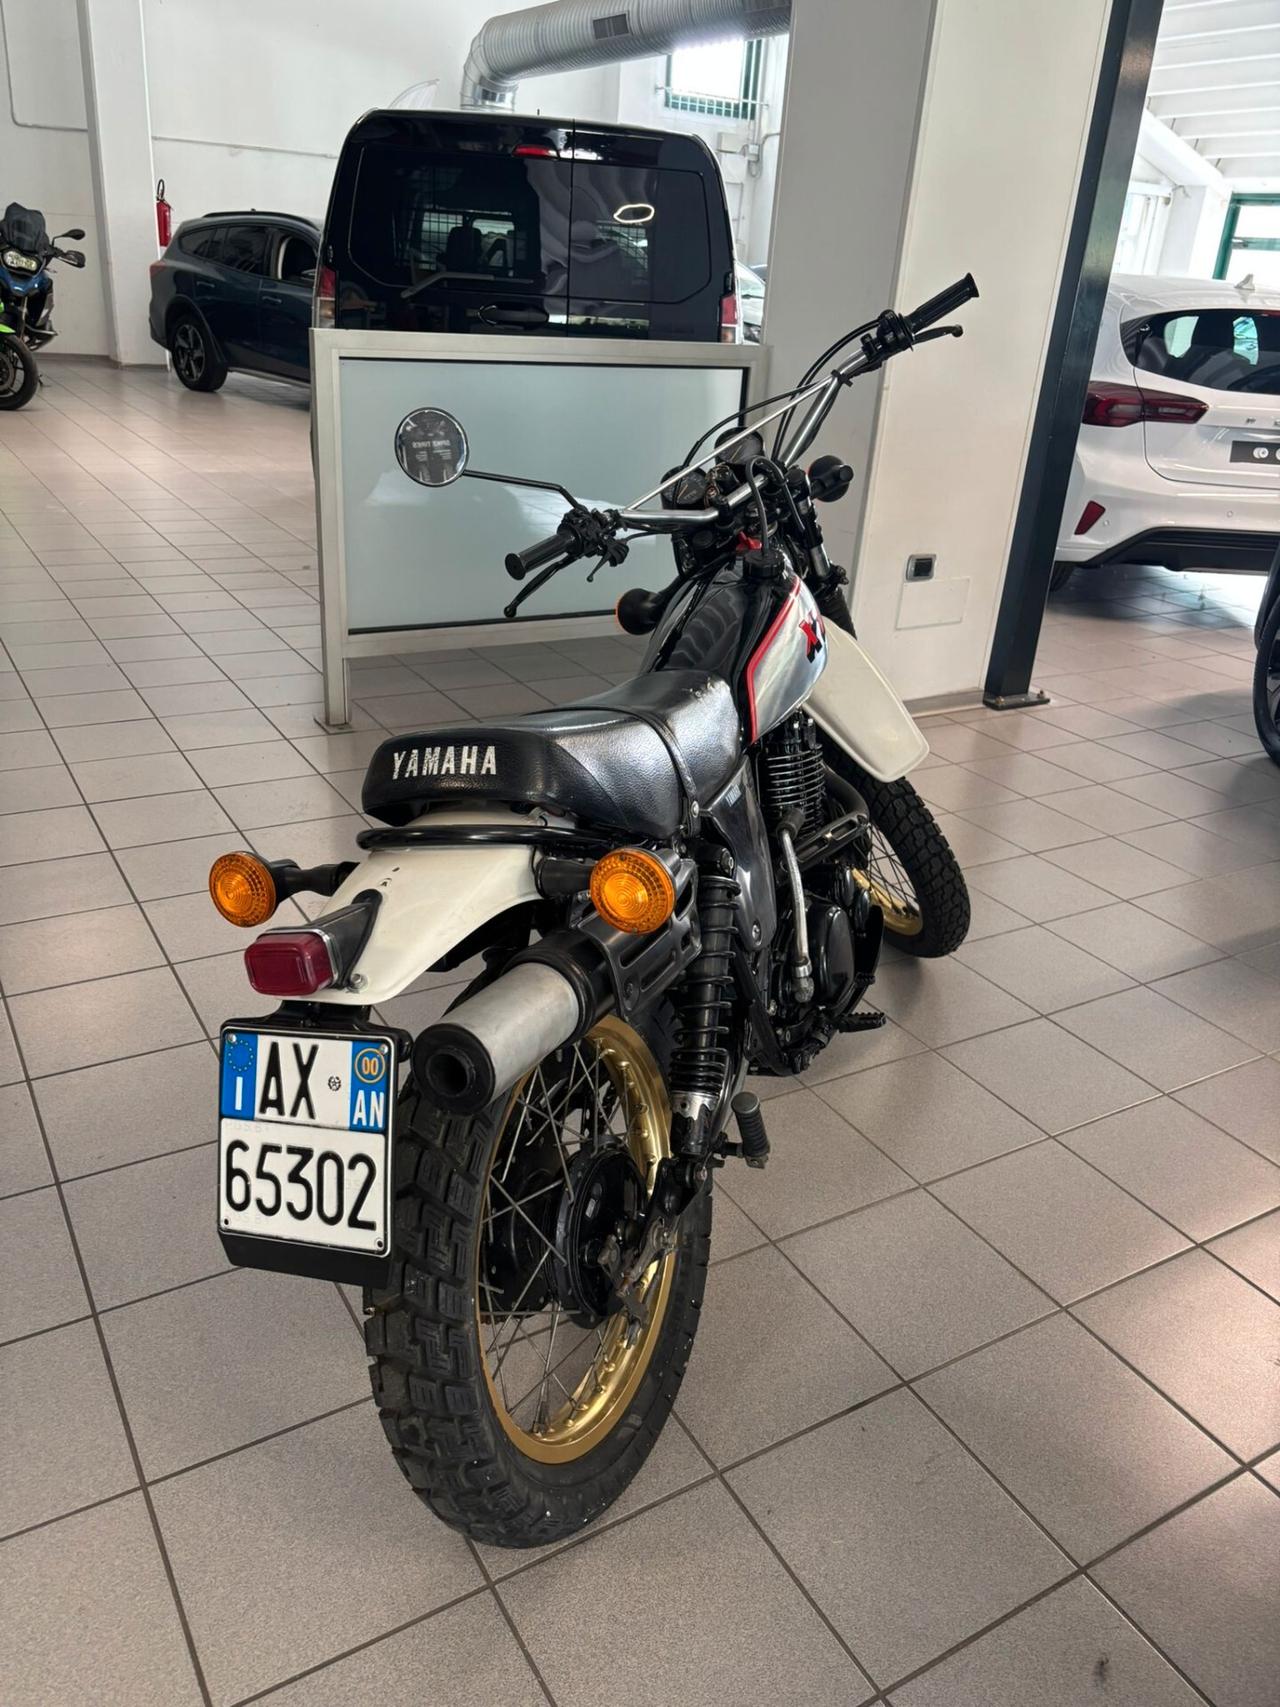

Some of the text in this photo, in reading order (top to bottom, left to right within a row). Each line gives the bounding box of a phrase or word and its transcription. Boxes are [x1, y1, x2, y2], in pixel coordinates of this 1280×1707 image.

[392, 745, 497, 780] YAMAHA
[234, 1076, 244, 1111] I
[258, 1041, 319, 1120] AX
[352, 1089, 385, 1128] AN
[225, 1139, 378, 1231] 65302
